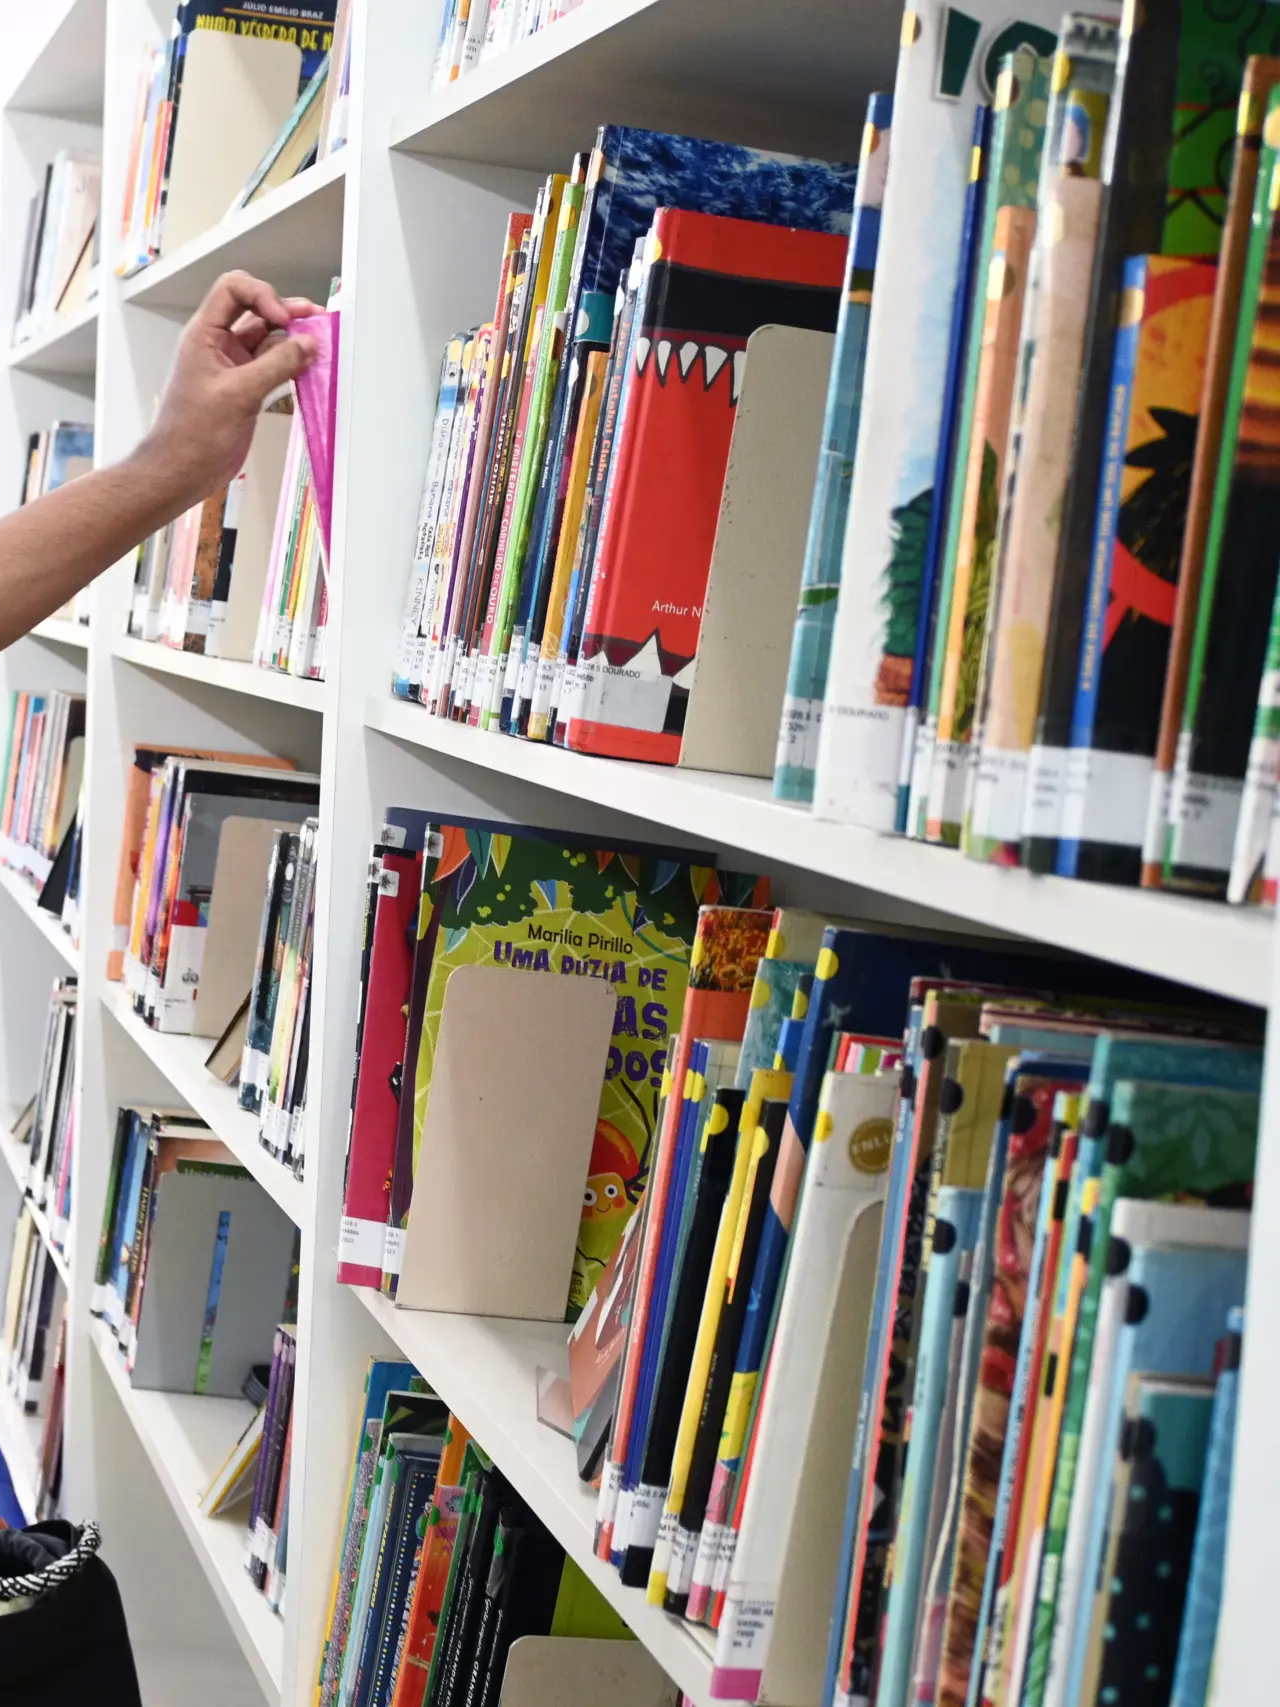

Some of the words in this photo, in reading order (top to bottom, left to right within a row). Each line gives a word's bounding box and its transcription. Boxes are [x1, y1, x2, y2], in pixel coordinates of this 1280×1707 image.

[300, 9, 324, 20] BRAZ
[301, 29, 319, 51] DE
[438, 418, 449, 449] Diário
[516, 430, 523, 438] O
[488, 464, 499, 505] MUITO
[496, 413, 507, 459] CAPETA
[598, 439, 610, 481] Clube
[426, 480, 439, 519] Banana
[495, 518, 509, 571] CARNEIRO
[411, 578, 424, 626] KINNEY
[487, 587, 498, 624] OURO
[651, 600, 688, 617] Arthur
[602, 666, 641, 678] DOURADO
[527, 923, 583, 947] Marilia
[588, 932, 633, 955] Pirillo
[493, 939, 550, 972] UMA
[560, 954, 627, 984] DÚZIA
[637, 967, 668, 992] DE
[380, 1522, 389, 1552] PARA
[371, 1554, 383, 1608] GAROTOS
[484, 1598, 492, 1621] Gente
[449, 1640, 462, 1687] GRANDES
